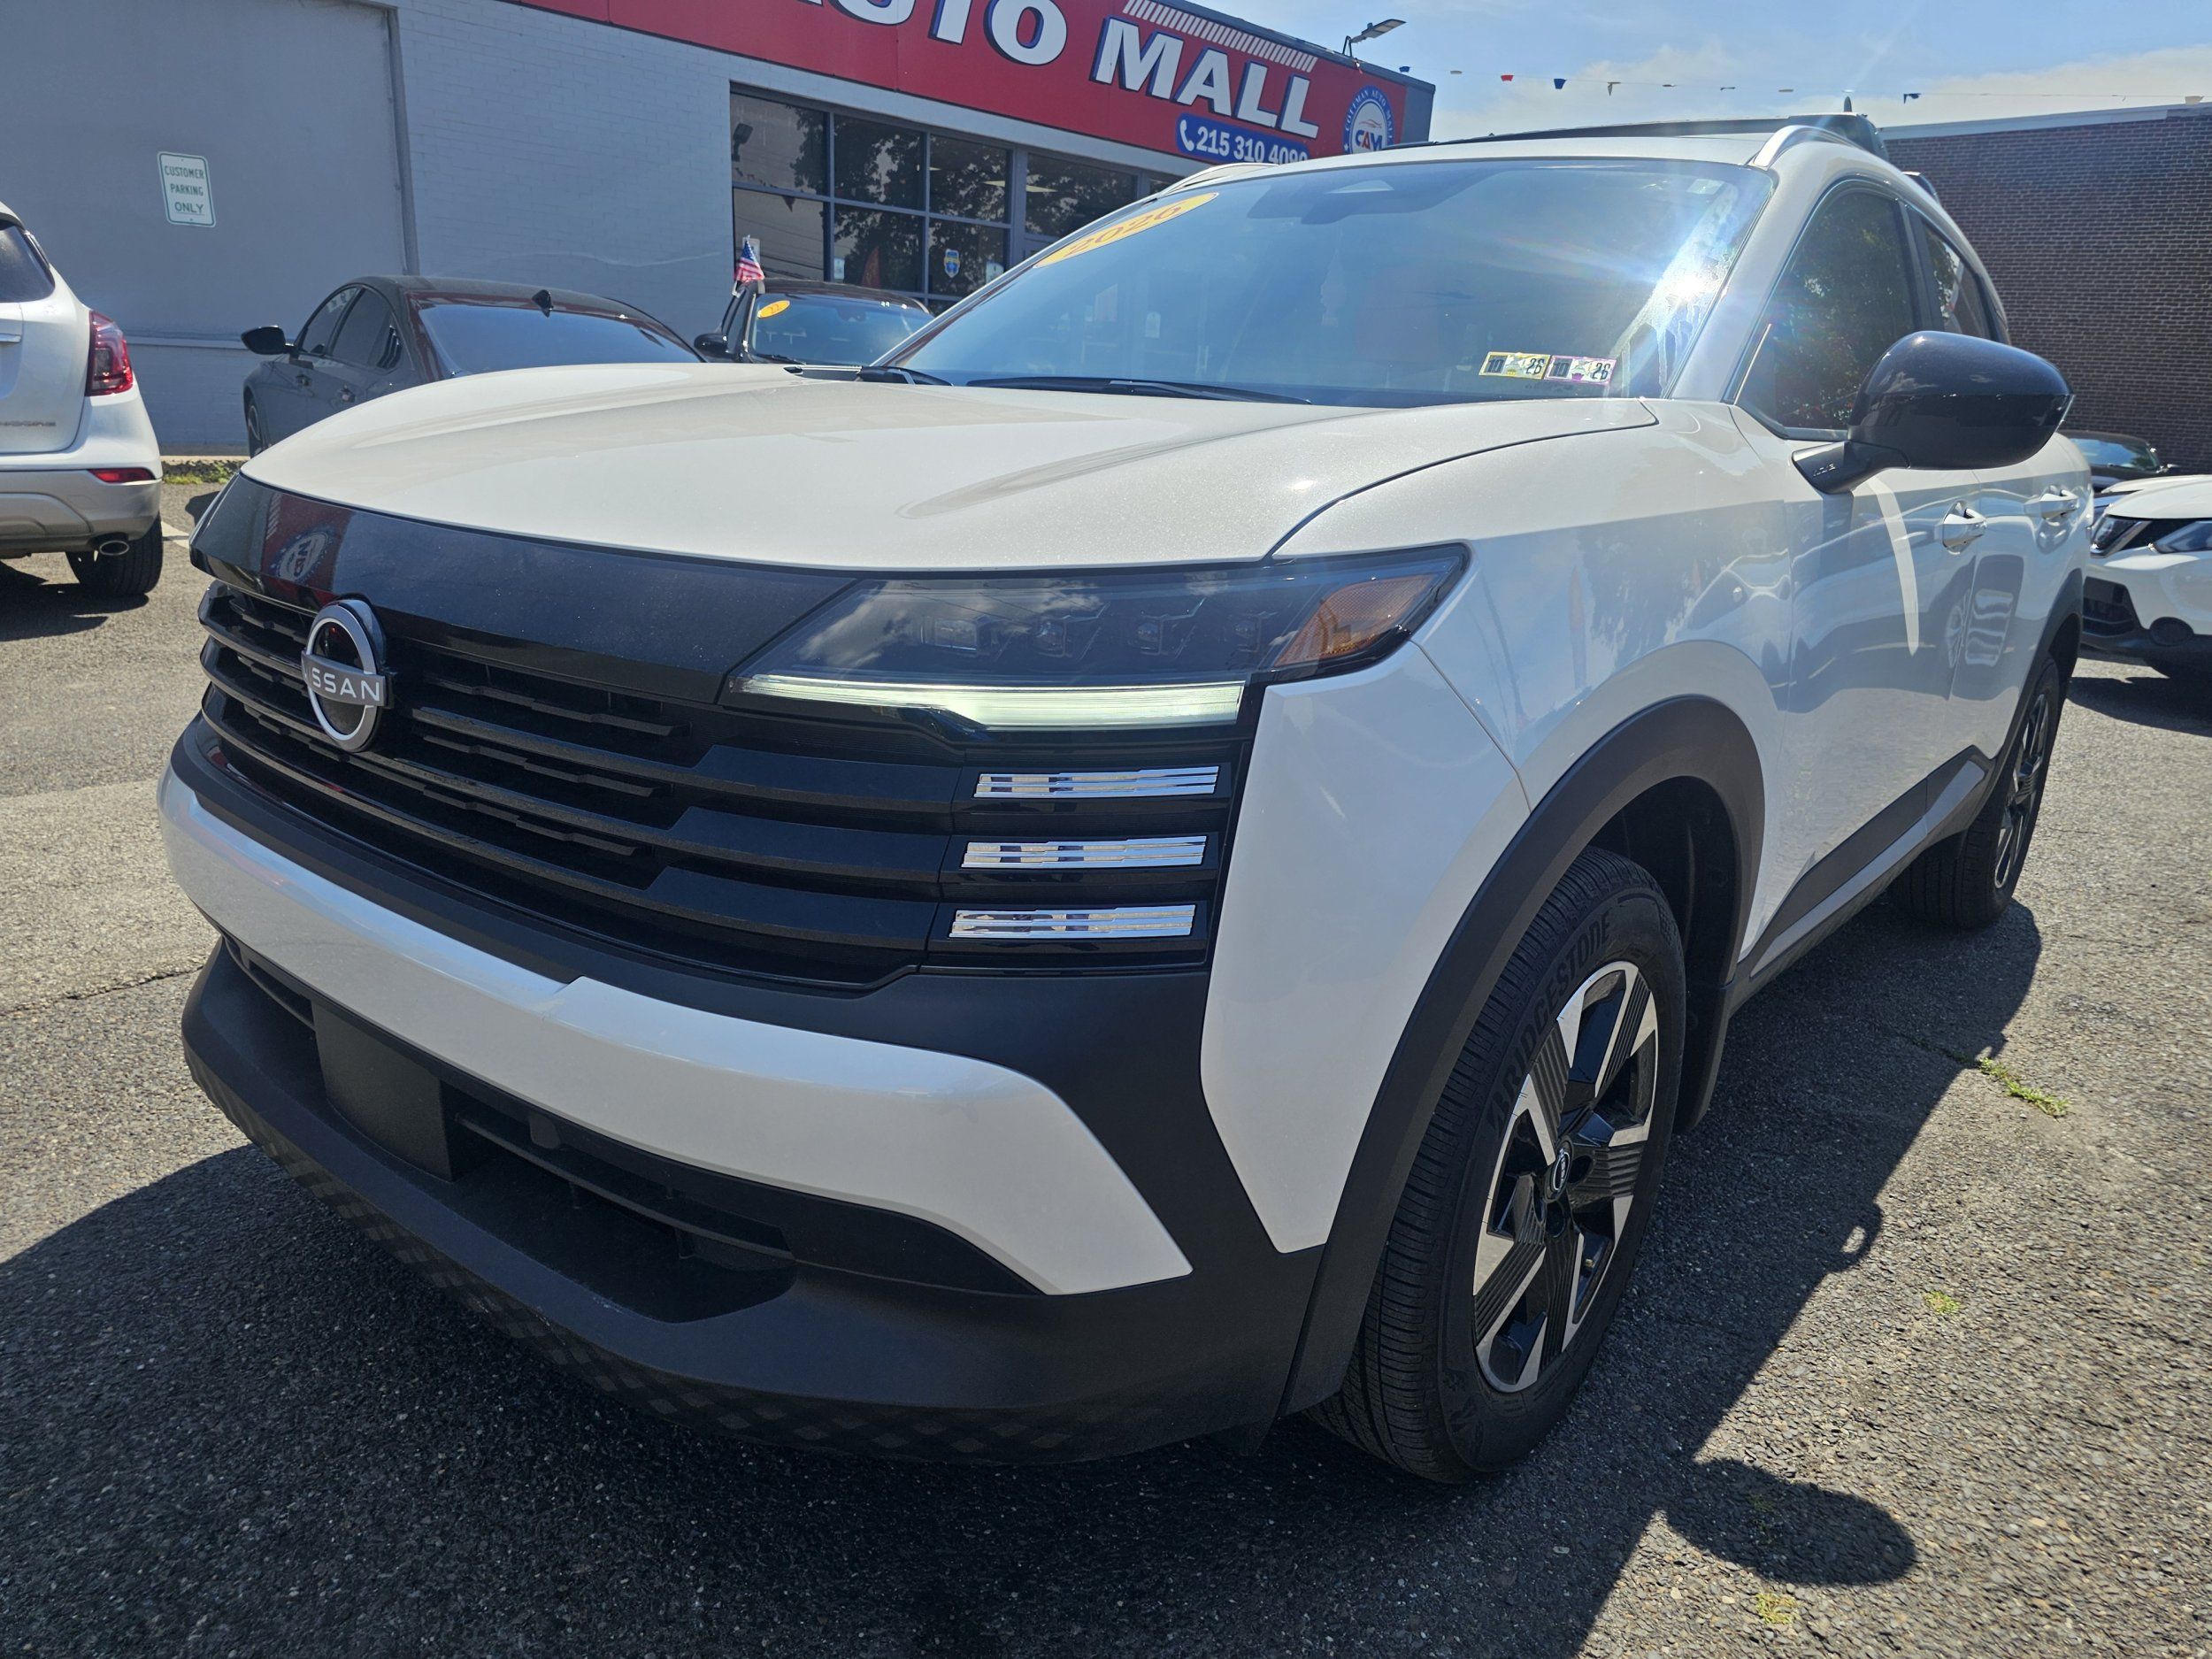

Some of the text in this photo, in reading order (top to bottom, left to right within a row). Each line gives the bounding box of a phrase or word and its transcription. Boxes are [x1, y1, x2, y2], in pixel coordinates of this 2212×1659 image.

[802, 0, 1319, 140] TO MALL
[1196, 126, 1230, 157] 215
[1233, 135, 1265, 163] 310
[1356, 129, 1383, 151] CAM
[164, 165, 205, 180] CUSTOMER
[170, 182, 204, 197] PARKING
[174, 201, 204, 213] ONLY
[1064, 200, 1188, 257] 2026
[1485, 357, 1546, 376] 10 26
[1549, 361, 1611, 380] 10 26
[1486, 908, 1612, 1138] BRIDGESTONE
